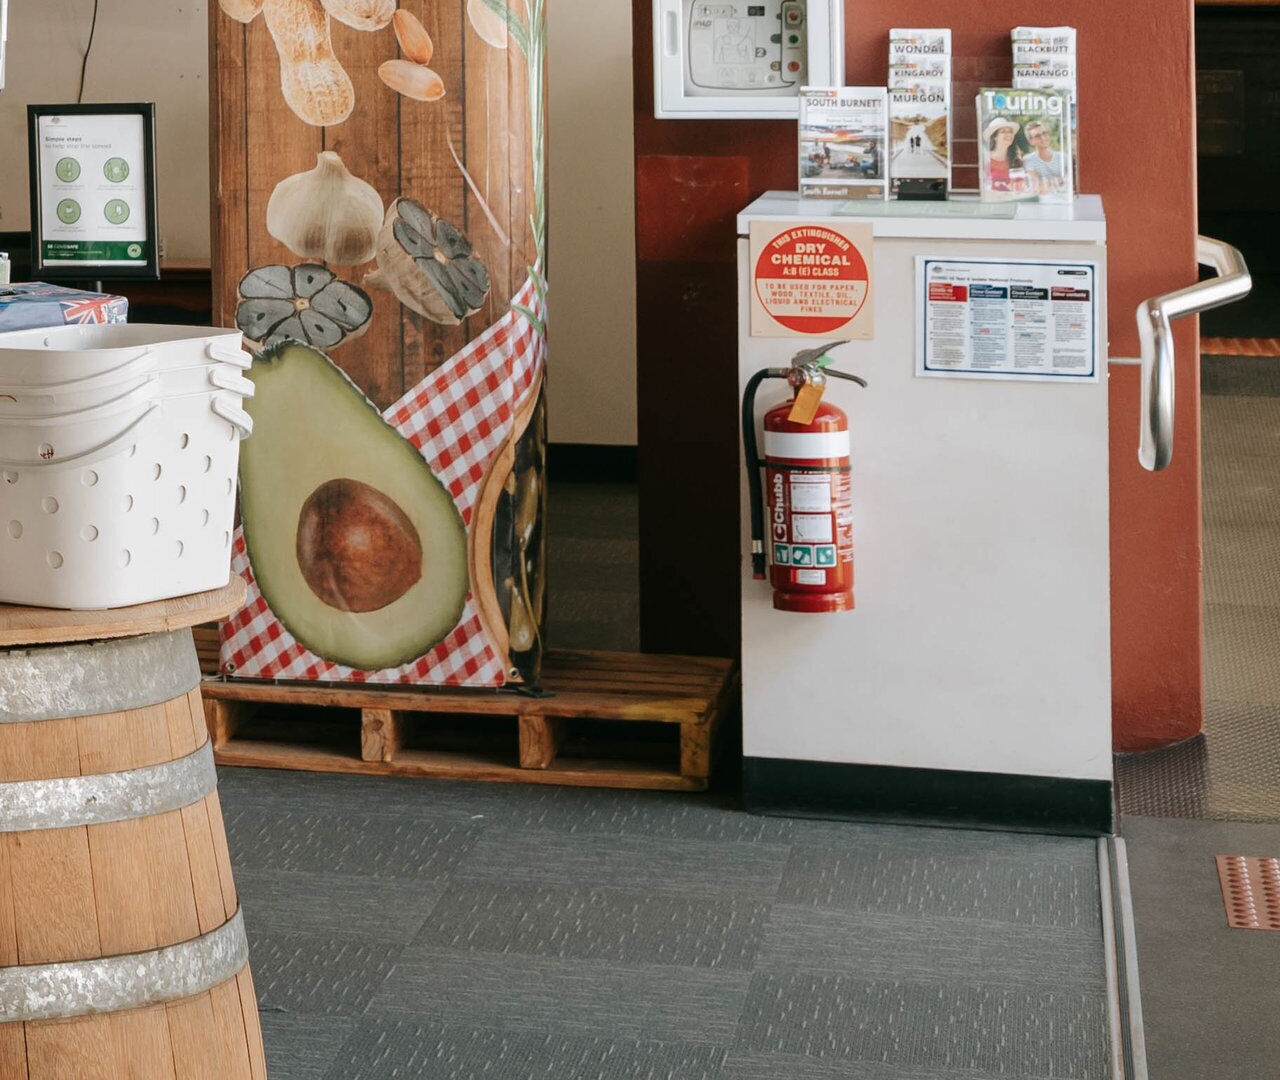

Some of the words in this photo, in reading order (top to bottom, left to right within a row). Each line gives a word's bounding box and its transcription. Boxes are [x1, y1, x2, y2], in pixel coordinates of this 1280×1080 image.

[1017, 45, 1069, 53] BLACKBUTT
[894, 70, 944, 78] KINGAROY
[1017, 70, 1069, 78] NANANGO
[806, 98, 838, 108] SOUTH
[840, 98, 882, 108] BURNETT
[893, 93, 945, 103] MURGON
[984, 92, 1063, 115] Touring
[772, 233, 791, 249] THIS
[790, 228, 851, 251] EXTINGUISHER
[795, 243, 826, 253] DRY
[771, 254, 851, 266] CHEMICAL
[812, 267, 839, 276] CLASS
[773, 473, 785, 524] Chubb
